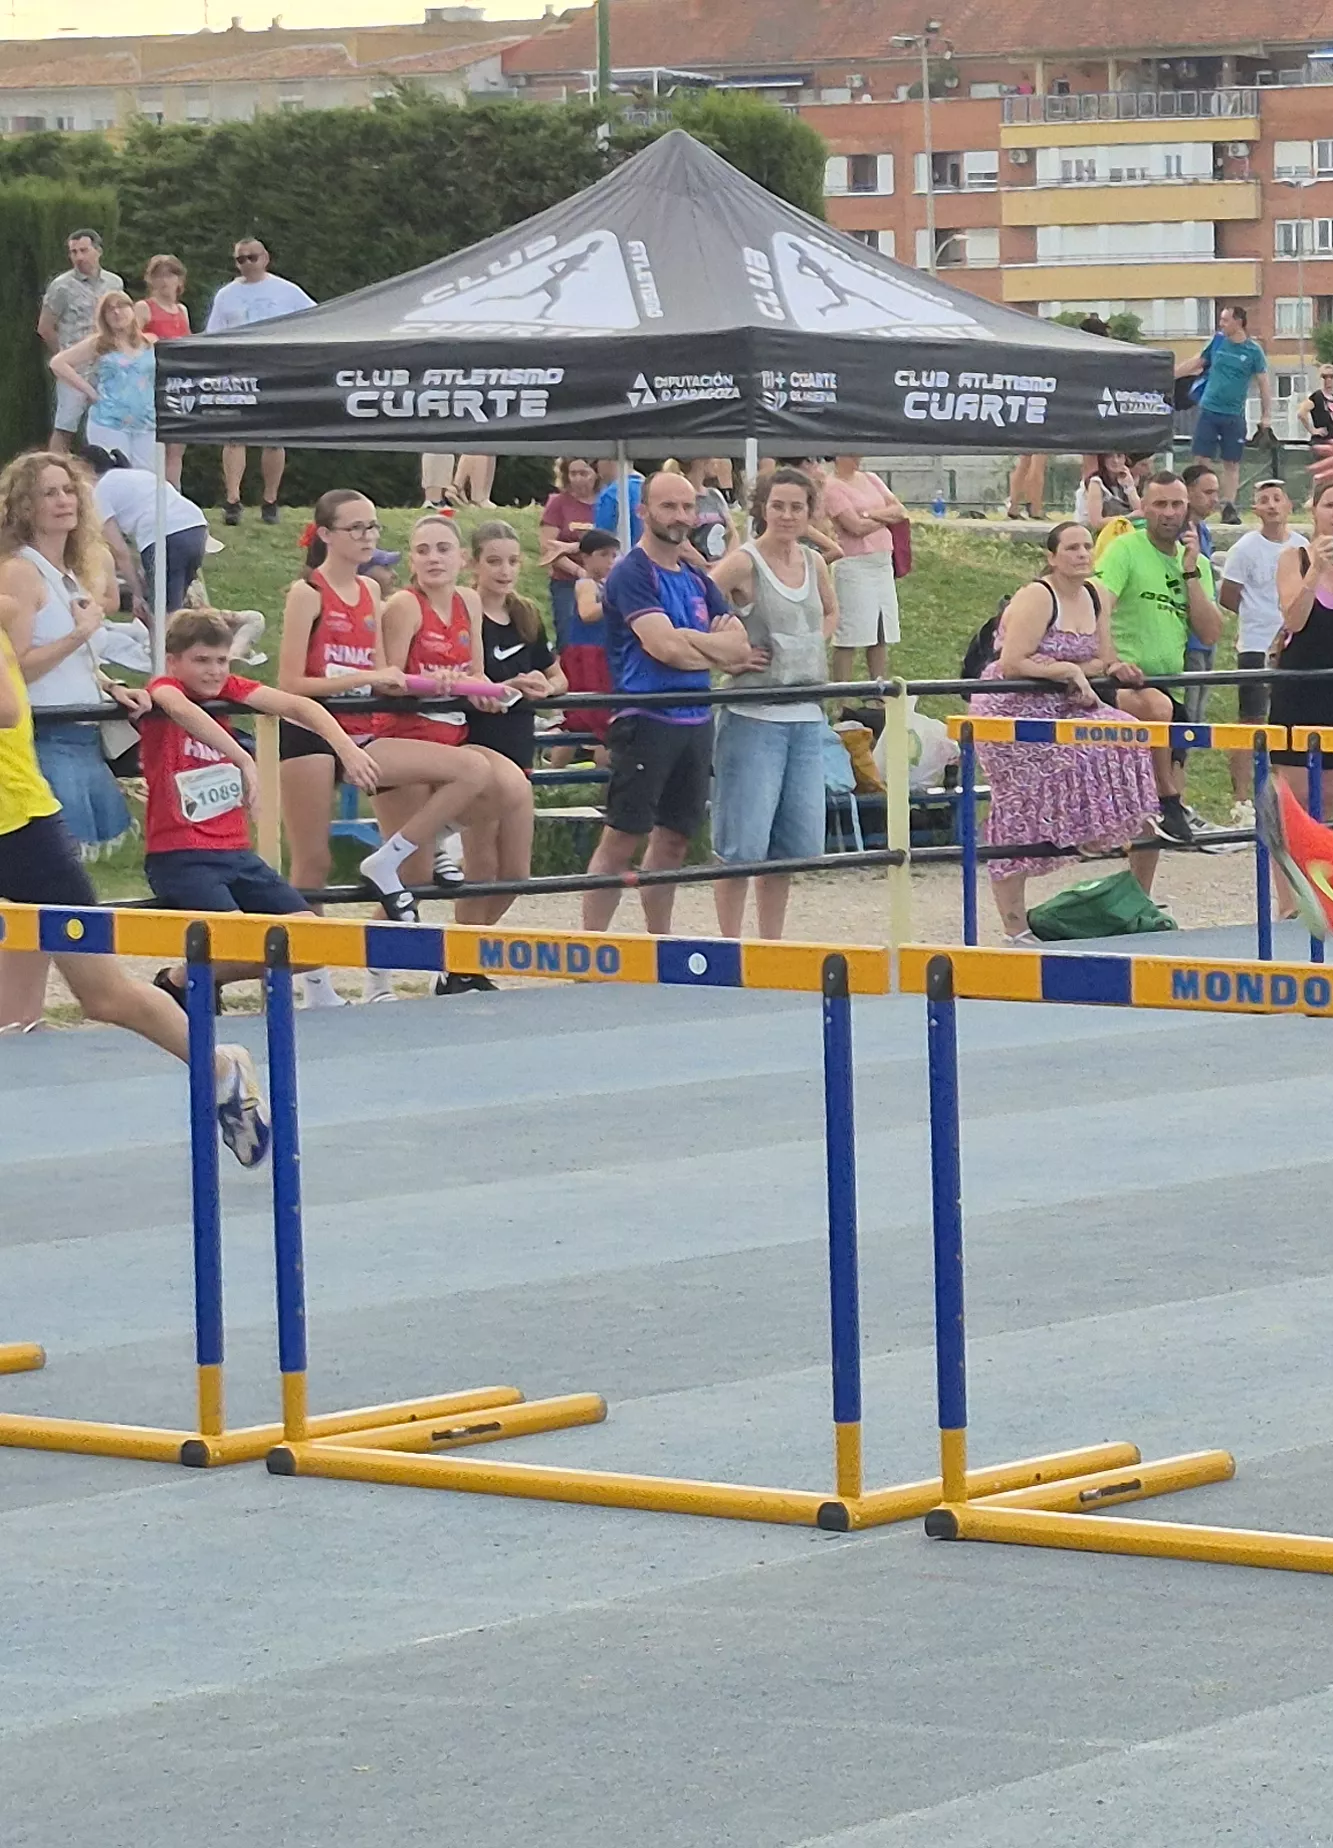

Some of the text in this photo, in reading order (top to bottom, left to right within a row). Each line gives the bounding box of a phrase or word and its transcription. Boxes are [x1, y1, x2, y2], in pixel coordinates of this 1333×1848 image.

[743, 247, 786, 321] CLUB
[199, 376, 261, 393] CUARTE
[335, 368, 565, 387] CLUB ATLETISMO
[654, 371, 734, 389] DIPUTACIÓN
[789, 371, 837, 389] CUARTE
[894, 370, 1057, 393] CLUB ATLETISMO
[673, 387, 741, 400] ZARAGOZA
[346, 389, 550, 423] CUARTE
[903, 391, 1048, 427] CUARTE
[1074, 726, 1149, 743] MONDO
[197, 782, 240, 805] 1089
[478, 938, 621, 974] MONDO
[1171, 969, 1331, 1008] MONDO
